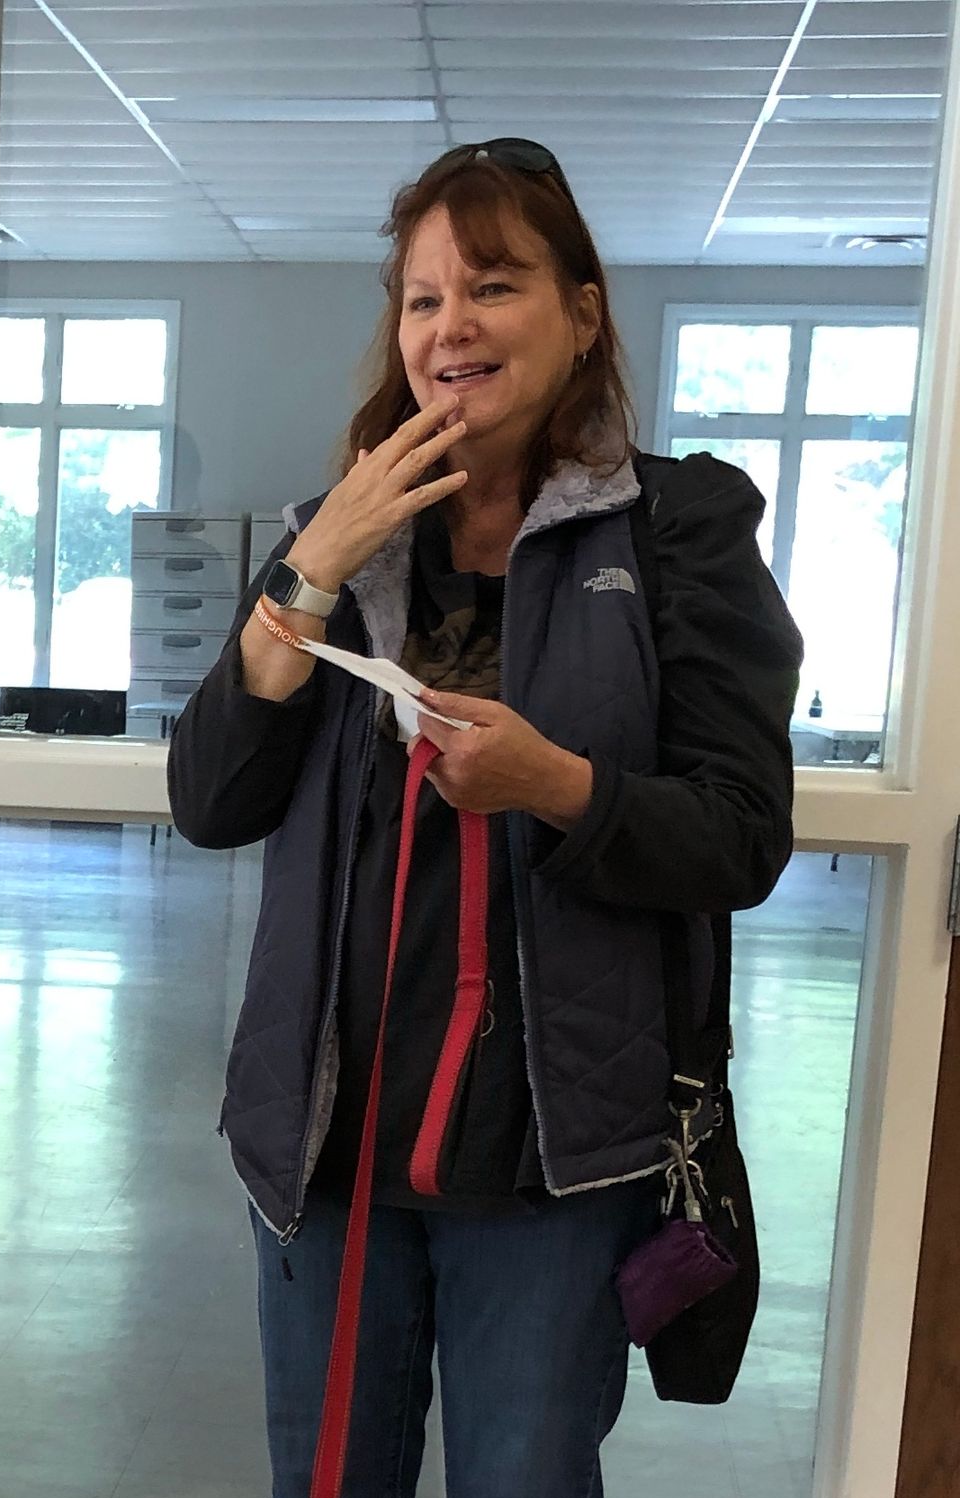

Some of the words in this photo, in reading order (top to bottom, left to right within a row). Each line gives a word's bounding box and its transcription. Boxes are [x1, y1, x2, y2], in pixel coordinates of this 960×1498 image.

[597, 567, 619, 577] THE
[583, 575, 619, 589] NORTH
[592, 582, 620, 593] FACE
